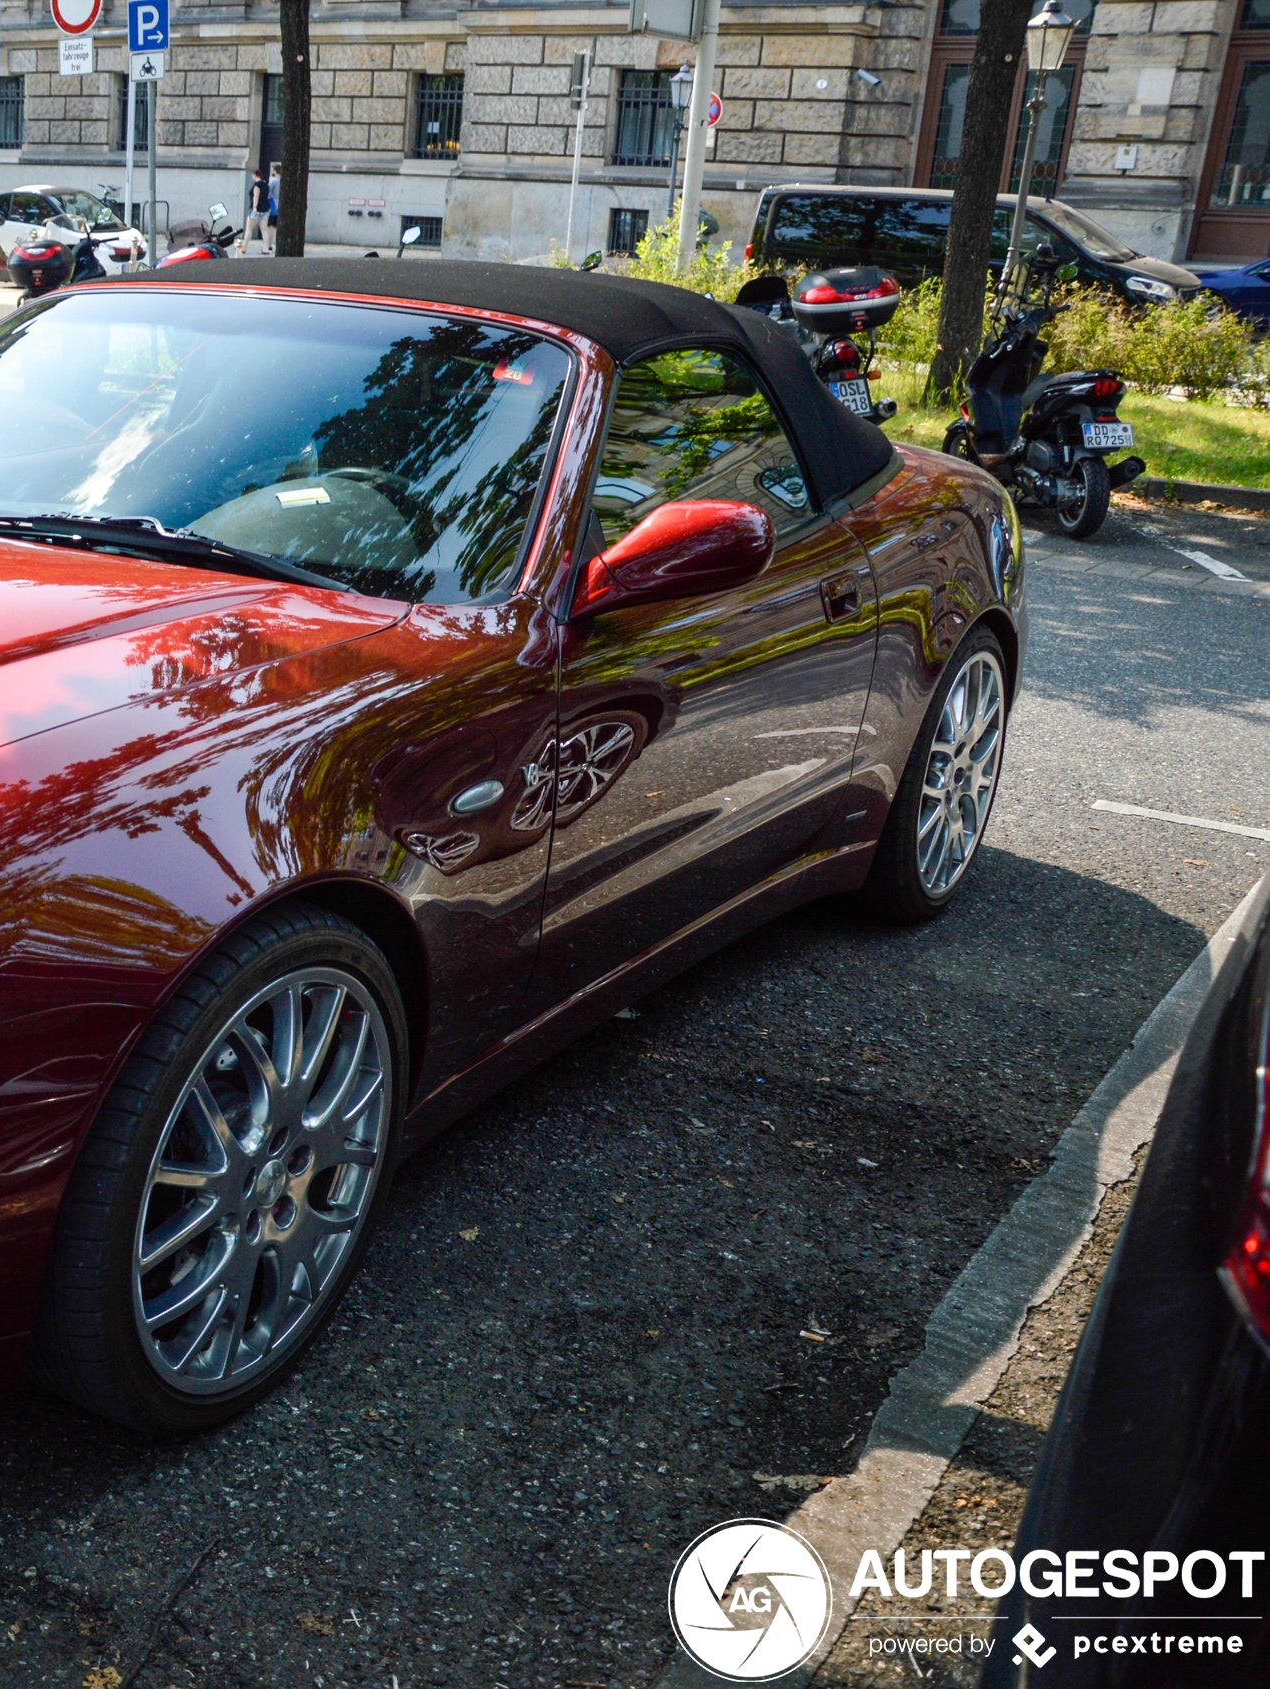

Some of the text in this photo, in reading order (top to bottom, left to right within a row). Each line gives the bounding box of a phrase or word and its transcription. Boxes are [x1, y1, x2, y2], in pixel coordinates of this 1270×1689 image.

[137, 5, 160, 45] P
[64, 42, 87, 51] Einsatz-
[62, 52, 89, 61] fahrzeuge
[71, 63, 81, 71] frei
[839, 381, 866, 398] OSL
[1093, 425, 1109, 436] DD
[520, 763, 539, 787] V8
